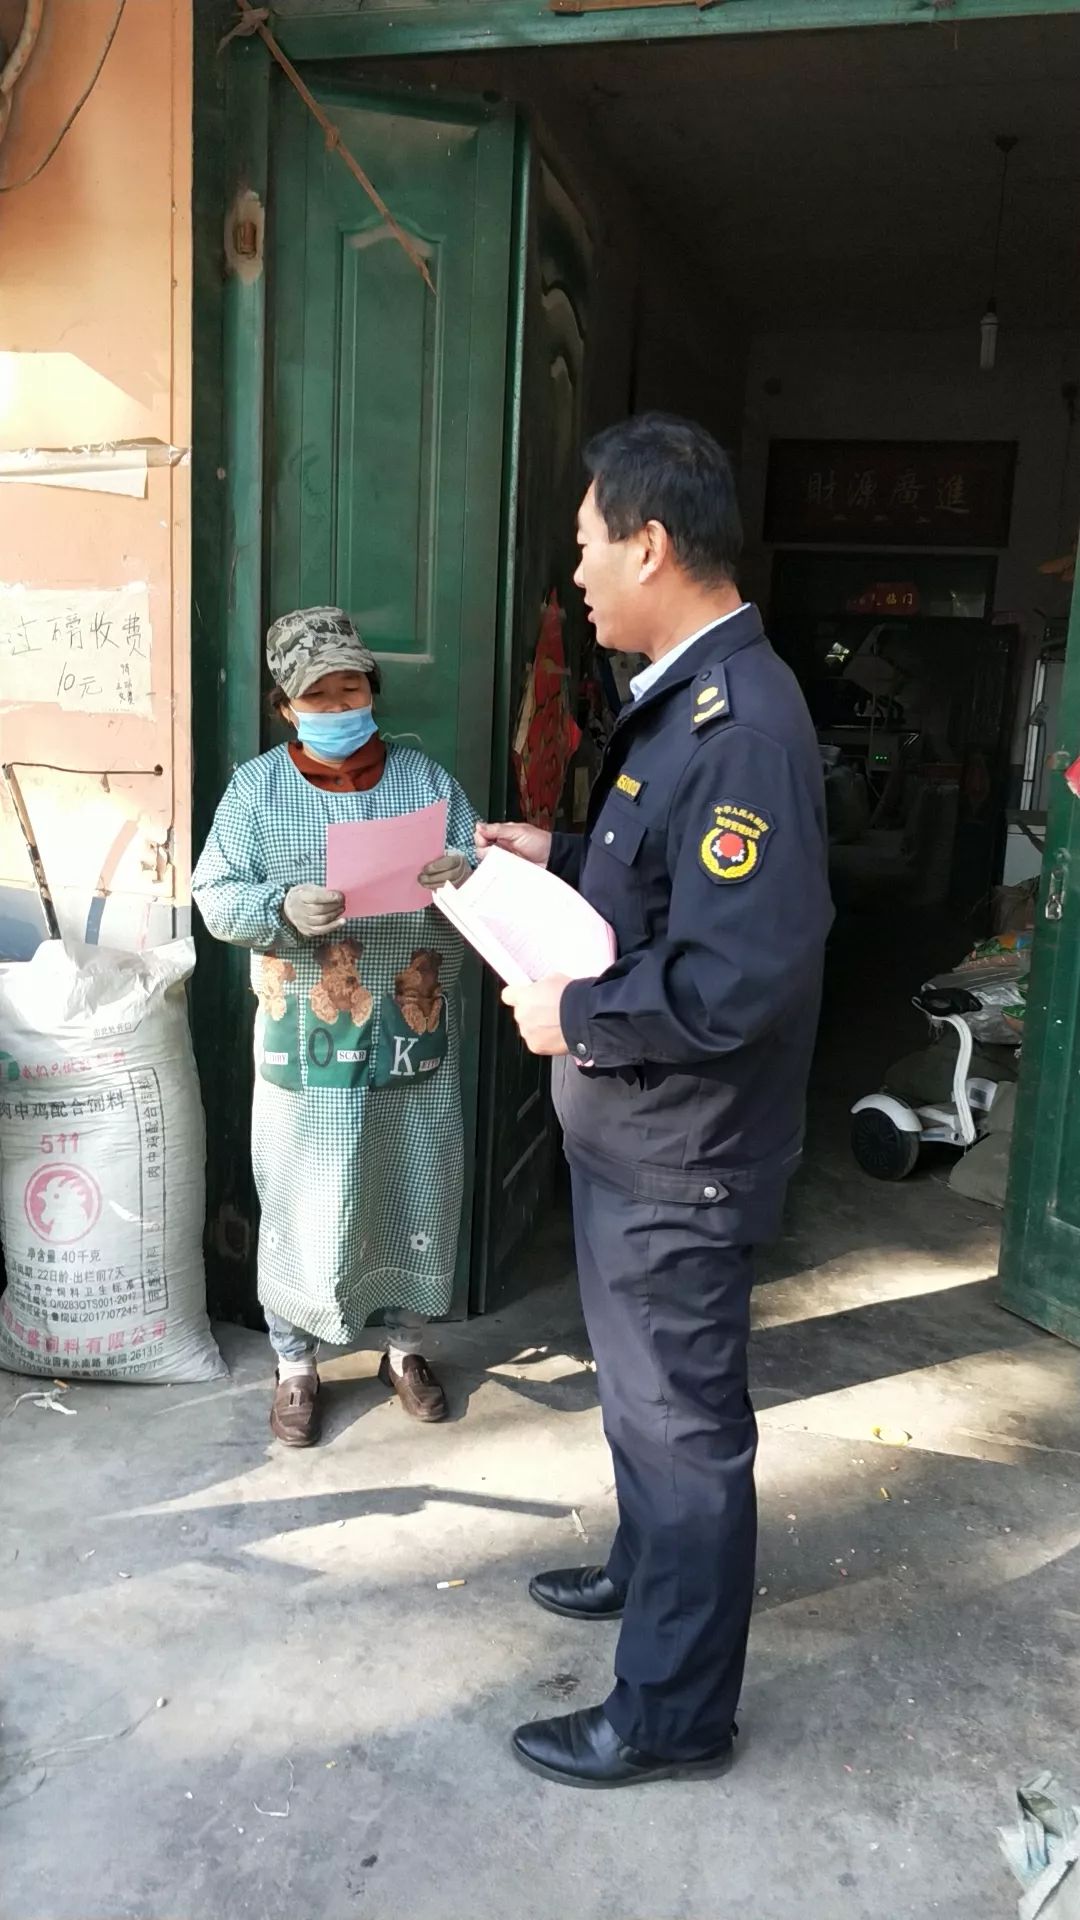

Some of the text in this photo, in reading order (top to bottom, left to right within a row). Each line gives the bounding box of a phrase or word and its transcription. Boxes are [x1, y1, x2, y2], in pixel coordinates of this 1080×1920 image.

[57, 662, 103, 699] 10元
[308, 1027, 365, 1068] O SCAR
[390, 1036, 420, 1076] K
[41, 1131, 80, 1154] 511
